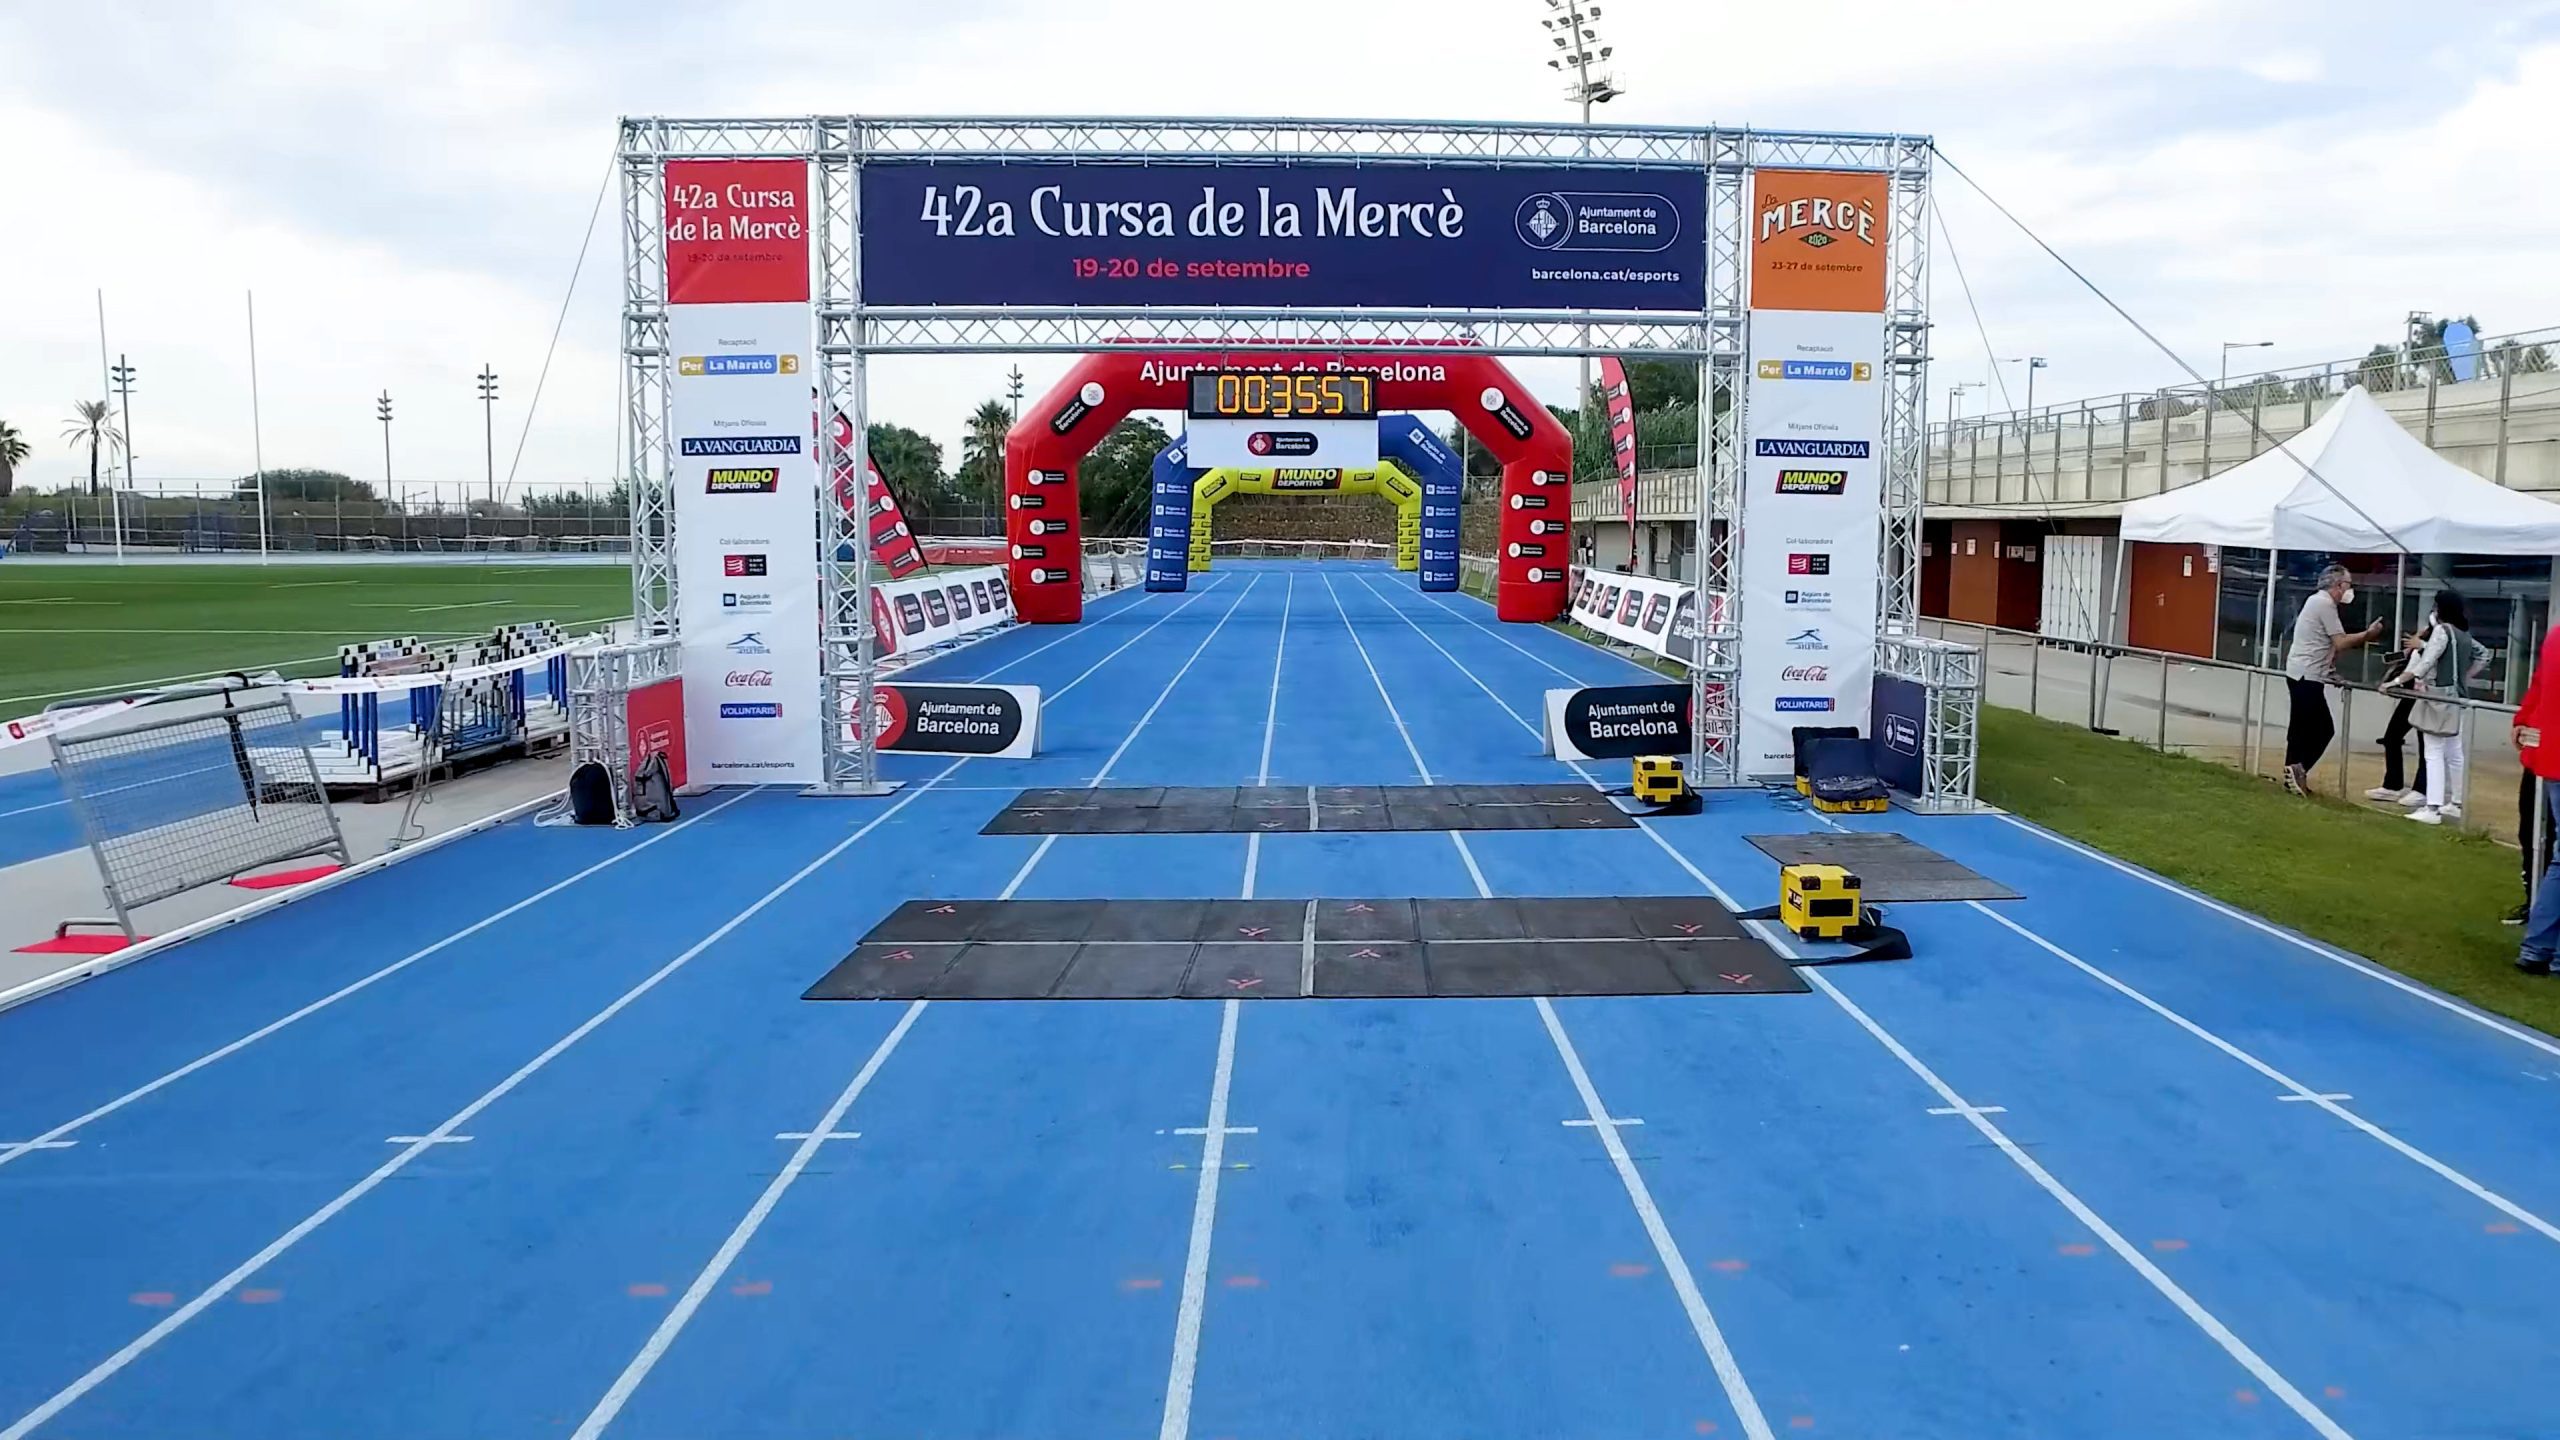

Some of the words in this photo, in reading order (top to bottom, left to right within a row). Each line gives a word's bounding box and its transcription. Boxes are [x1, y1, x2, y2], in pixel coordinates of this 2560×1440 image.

[673, 185, 718, 209] 42a
[726, 184, 795, 208] Cursa
[920, 184, 1015, 237] 42a
[1030, 184, 1175, 237] Cursa
[1188, 187, 1245, 237] de
[1258, 187, 1303, 237] la
[1316, 187, 1464, 238] Mercè
[1579, 206, 1641, 219] Ajuntament
[1643, 207, 1656, 218] de
[669, 217, 696, 241] de
[702, 216, 724, 240] la
[729, 215, 801, 240] Mercè
[1579, 220, 1657, 235] Barcelona
[1761, 197, 1875, 247] MERCÈ
[1807, 234, 1828, 246] 2020
[1073, 258, 1139, 278] 19-20
[1146, 257, 1179, 278] de
[1186, 258, 1311, 278] setembre
[1772, 262, 1798, 271] 23-27
[1801, 263, 1813, 271] de
[1815, 263, 1863, 272] setembre
[1532, 268, 1680, 284] barcelona.cat/esports
[681, 361, 704, 371] Per
[709, 361, 724, 370] La
[727, 359, 773, 370] Marató
[1760, 365, 1781, 375] Per
[1787, 365, 1801, 375] La
[1803, 366, 1847, 377] Marató
[712, 470, 773, 482] MUNDO
[1279, 468, 1338, 480] MUNDO
[1783, 472, 1842, 485] MUNDO
[711, 482, 761, 490] DEPORTIVO
[1782, 483, 1829, 491] DEPORTIVO
[721, 705, 776, 715] VOLUNTARIS
[919, 701, 985, 716] Ajuntament
[987, 703, 1002, 715] de
[1588, 702, 1659, 719] Ajuntament
[1660, 701, 1675, 713] de
[1777, 700, 1829, 709] VOLUNTARIS
[917, 717, 999, 735] Barcelona
[1589, 718, 1678, 739] Barcelona
[711, 761, 795, 769] barcelona.cat/esports
